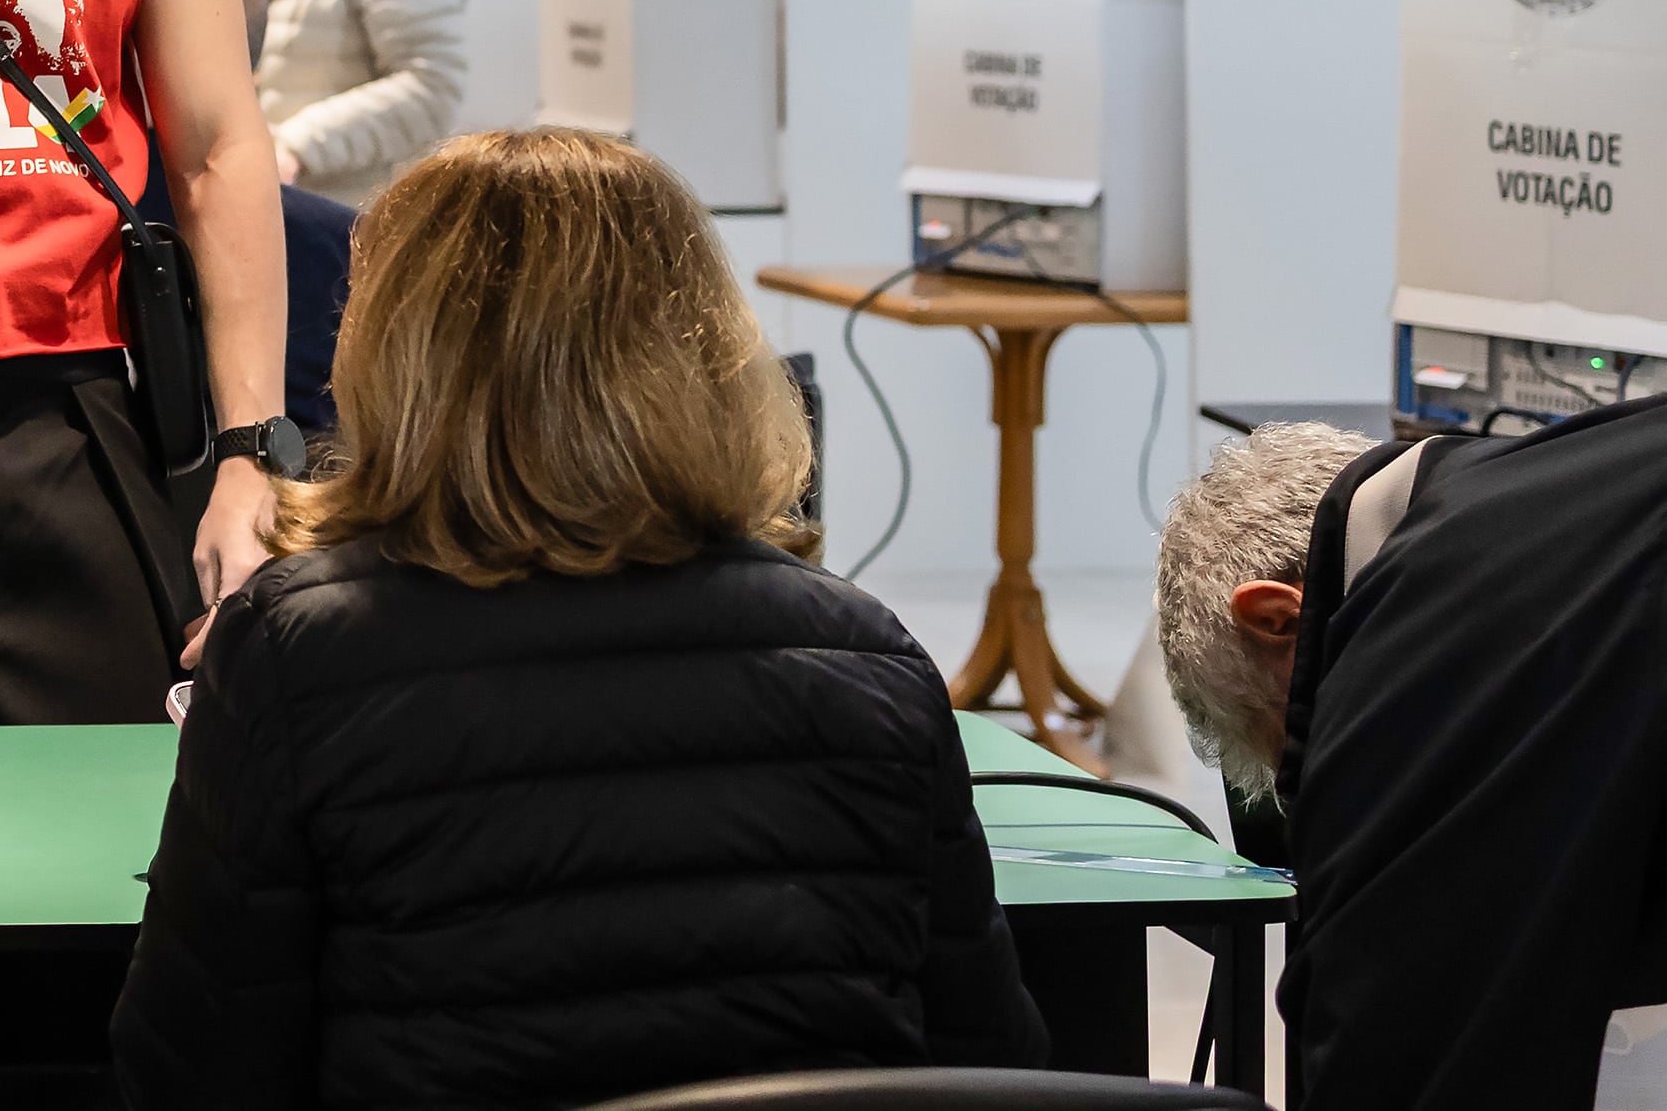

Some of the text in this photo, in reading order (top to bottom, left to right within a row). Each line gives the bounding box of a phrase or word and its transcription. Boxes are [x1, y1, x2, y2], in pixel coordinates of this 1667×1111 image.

[1487, 119, 1622, 167] CABINA DE
[20, 158, 48, 175] DE
[49, 159, 89, 178] NOVO
[1496, 169, 1613, 217] VOTAÇÃO
